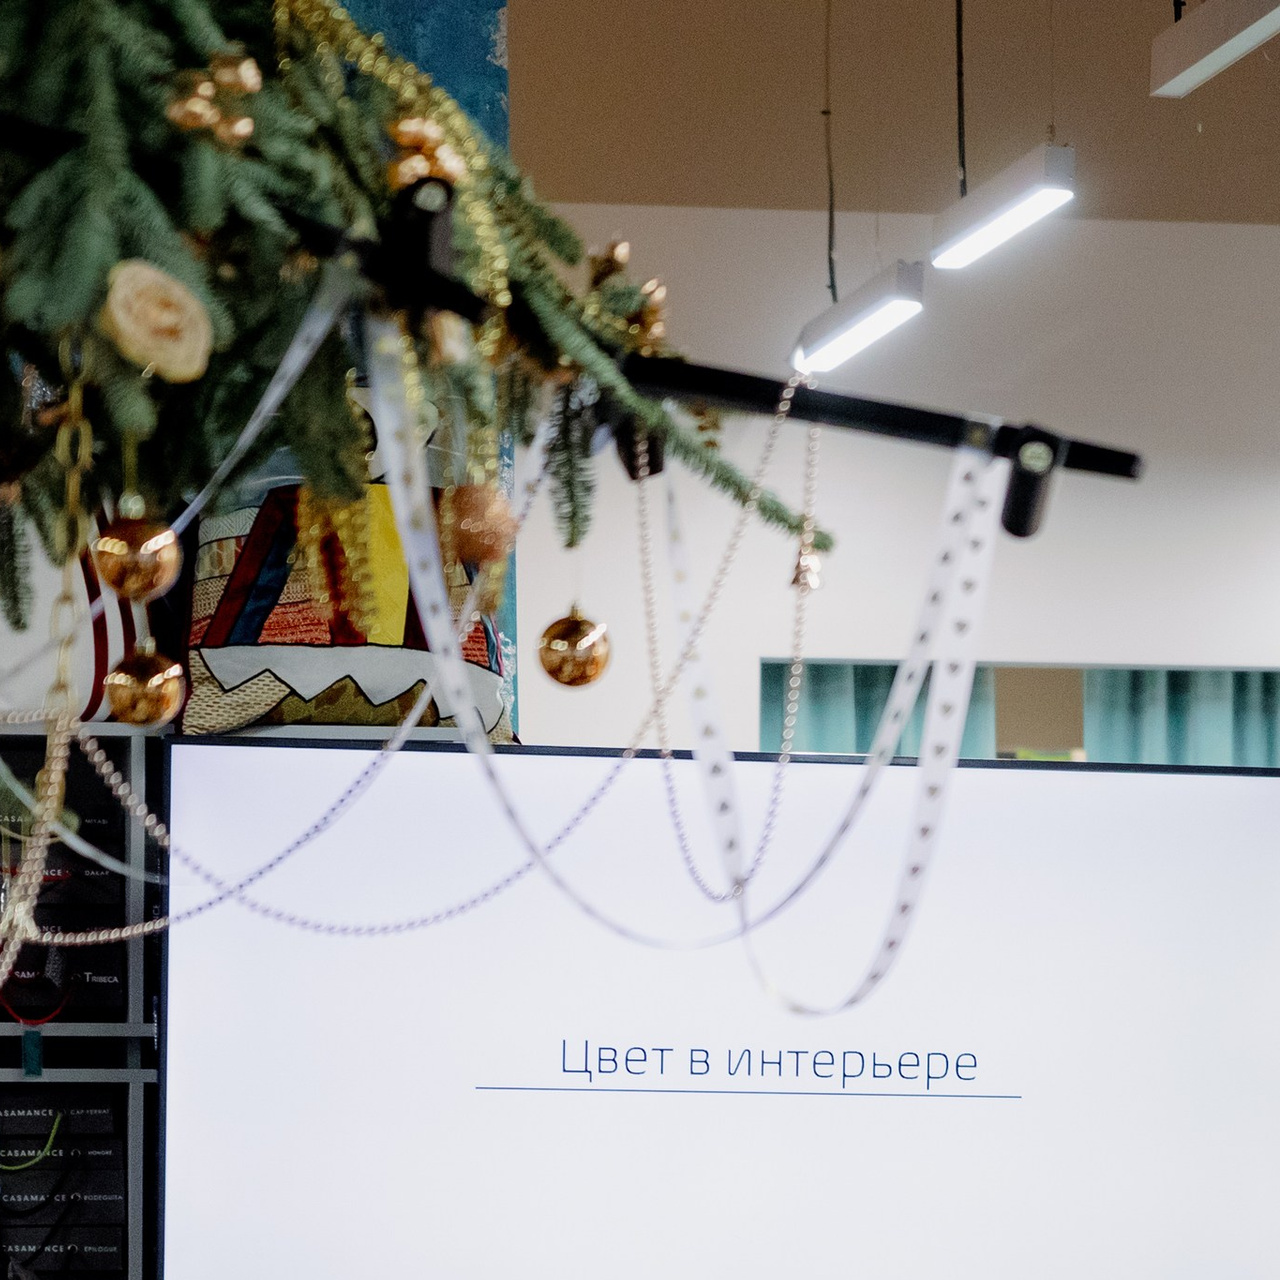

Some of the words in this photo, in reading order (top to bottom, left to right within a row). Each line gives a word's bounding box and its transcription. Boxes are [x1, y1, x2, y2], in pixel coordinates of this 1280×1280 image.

[561, 1039, 674, 1083] Цвет
[689, 1048, 710, 1076] в
[727, 1048, 979, 1090] интерьере
[0, 1109, 54, 1117] ASAMANCE
[2, 1194, 67, 1202] CASAMACE
[2, 1244, 65, 1253] ASAMNCE
